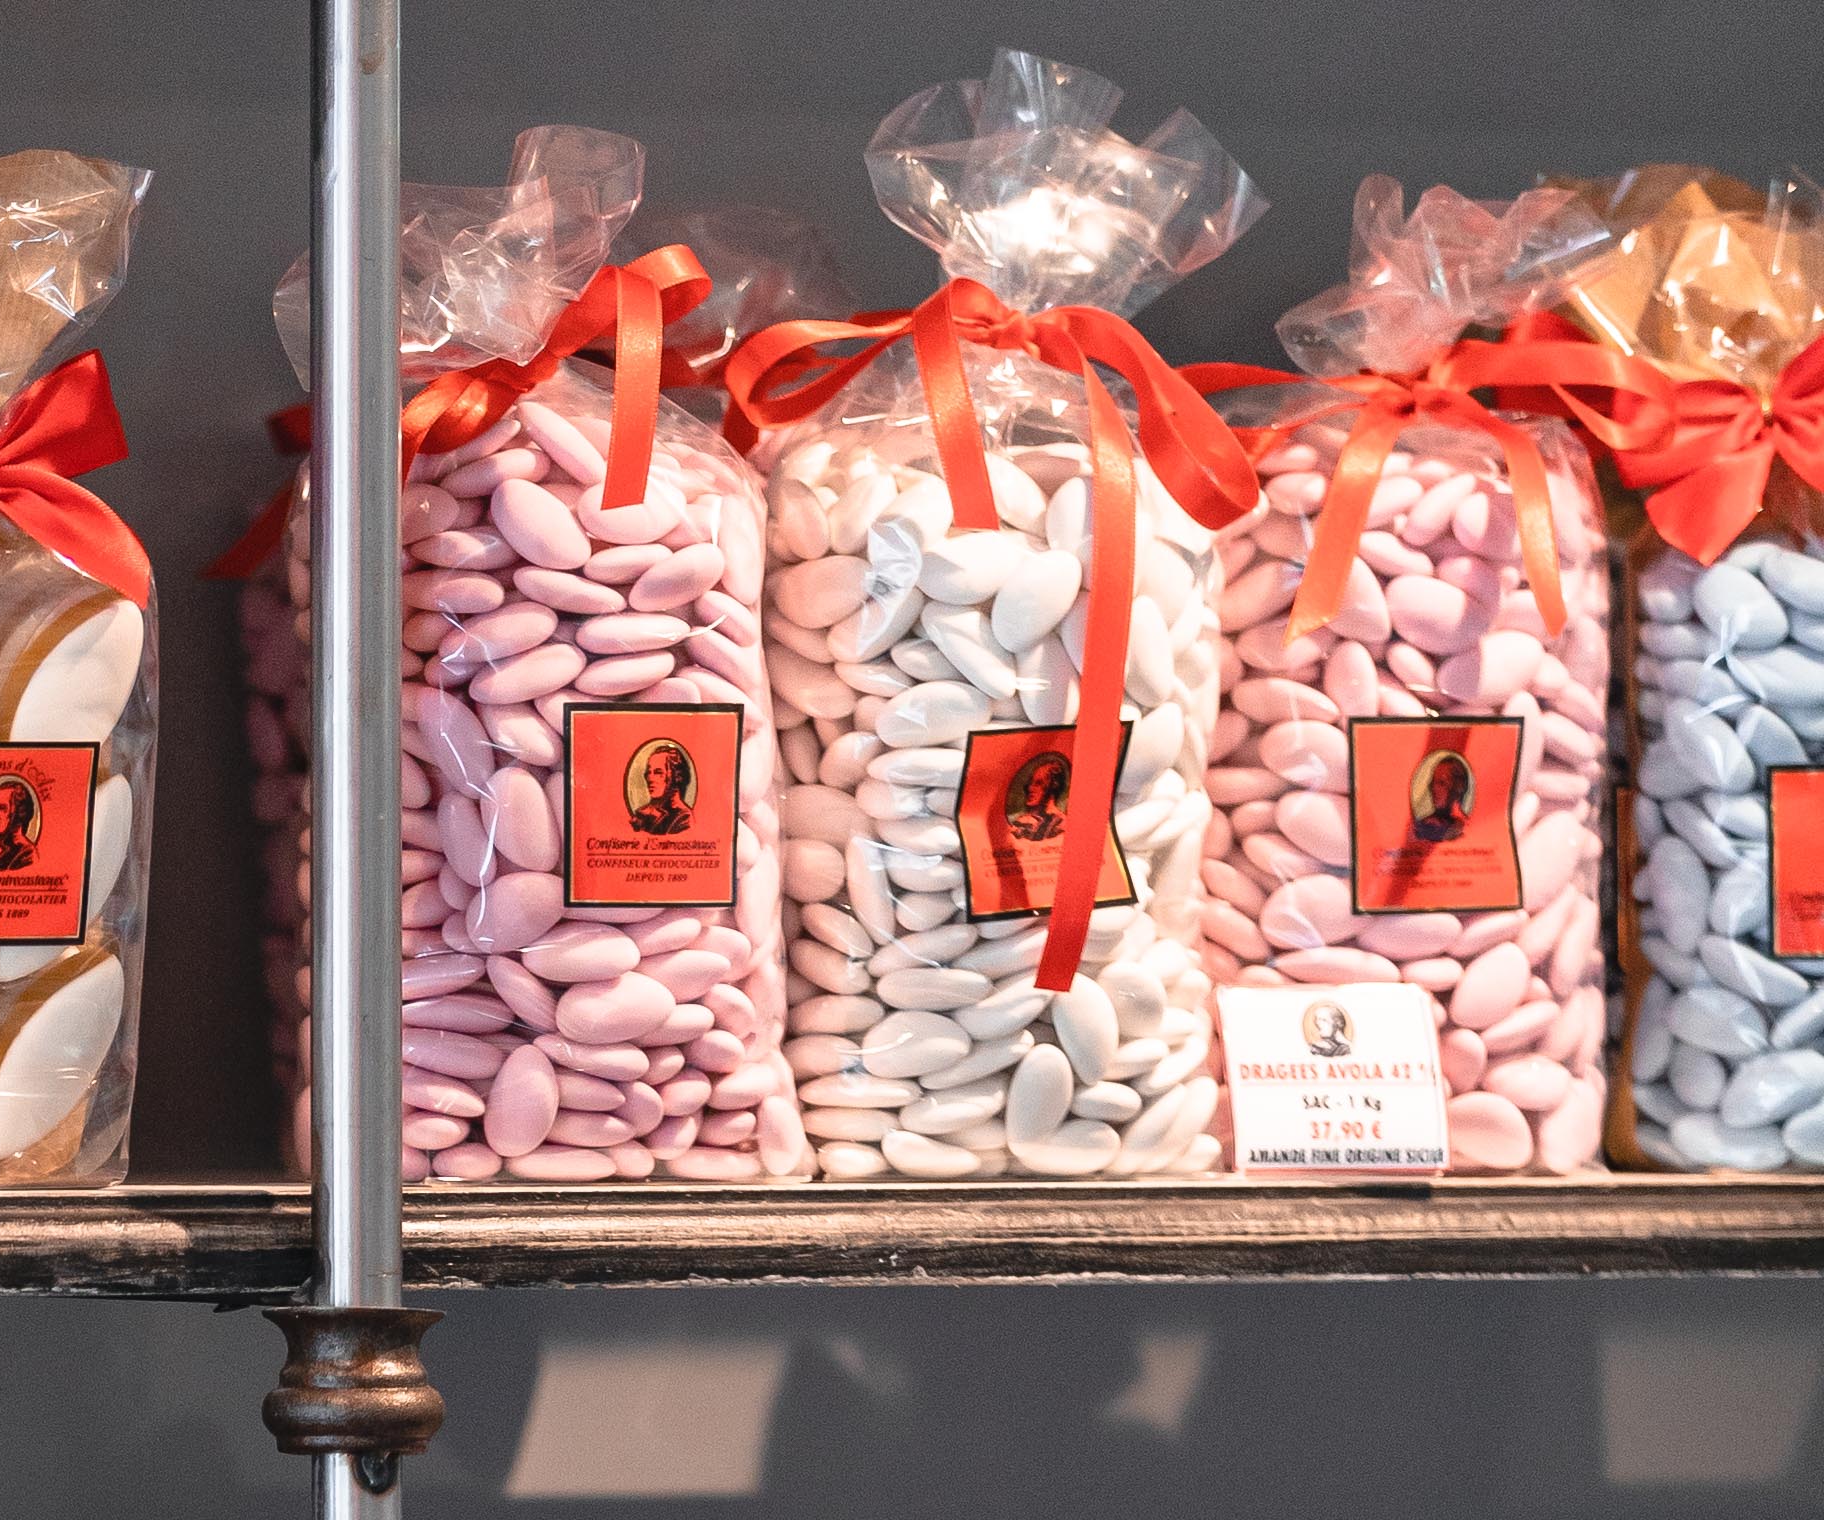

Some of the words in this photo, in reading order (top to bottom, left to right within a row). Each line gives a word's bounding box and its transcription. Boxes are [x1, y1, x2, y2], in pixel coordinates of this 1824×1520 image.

[586, 838, 640, 854] Confiserie
[587, 859, 649, 868] CONFISEUR
[652, 859, 720, 869] CHOCOLATIER
[625, 873, 665, 882] DEPUIS
[1327, 1064, 1384, 1080] AVOLA
